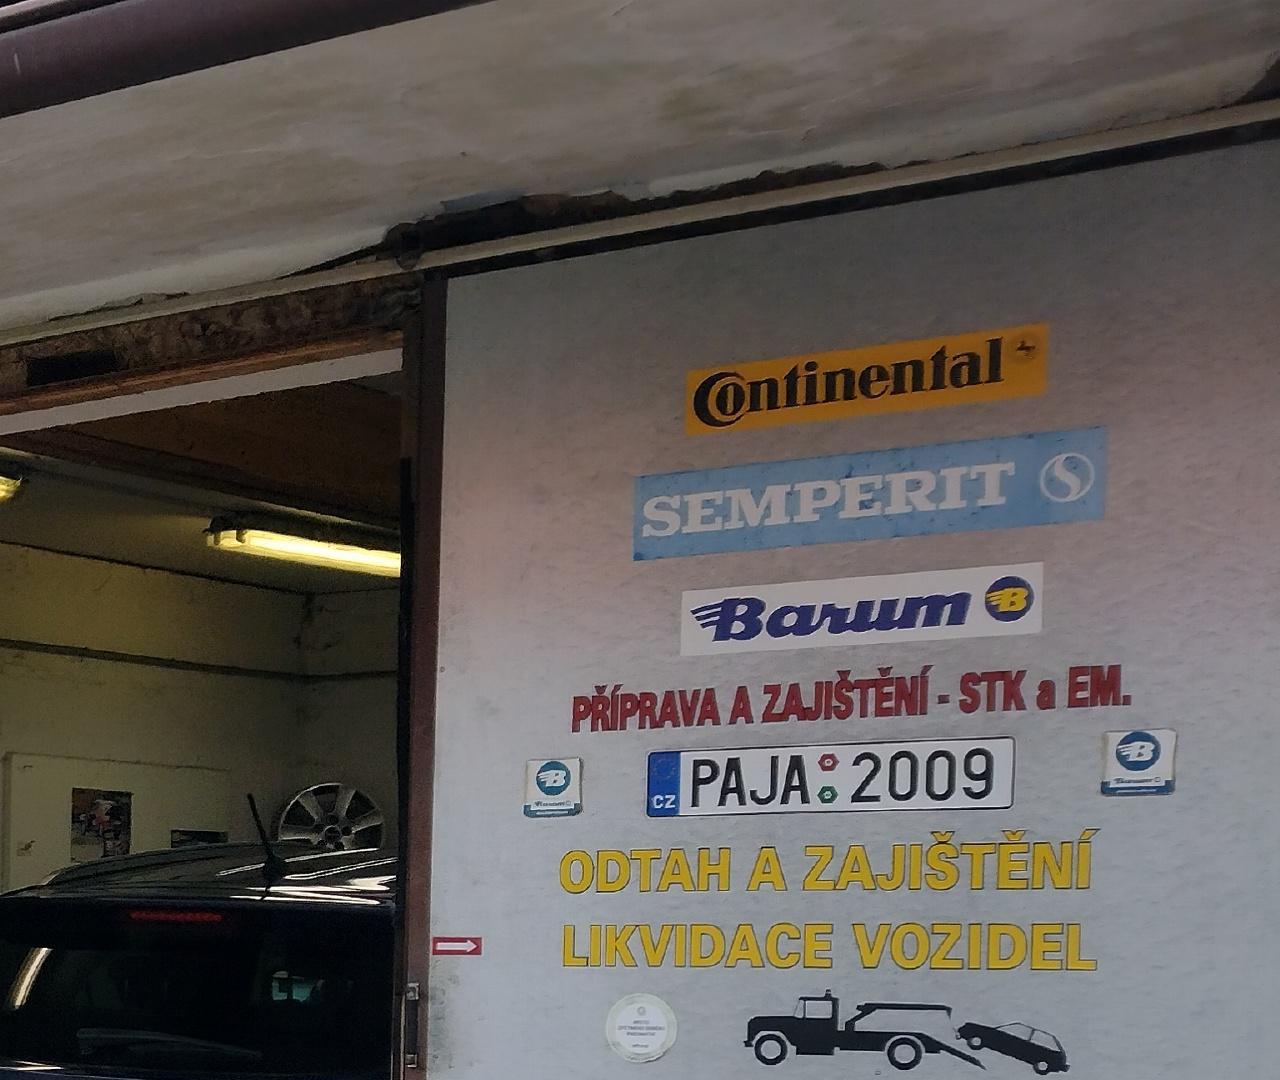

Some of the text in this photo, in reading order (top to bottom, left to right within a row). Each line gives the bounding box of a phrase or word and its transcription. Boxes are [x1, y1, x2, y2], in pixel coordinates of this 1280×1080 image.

[694, 337, 1004, 427] Continental
[641, 462, 1015, 537] SEMPERIT
[691, 587, 972, 642] Barum
[572, 683, 720, 733] PŘÍPRAVA
[730, 685, 753, 727] A
[761, 665, 933, 723] ZAJIŠTĚNÍ
[958, 669, 1027, 715] STK
[1067, 664, 1132, 709] EM.
[652, 747, 996, 810] CZ PAJA 2009
[559, 828, 1101, 895] ODTAH A ZAJIŠTĚNÍ
[562, 921, 1099, 971] LIKVIDACE VOZIDEL
